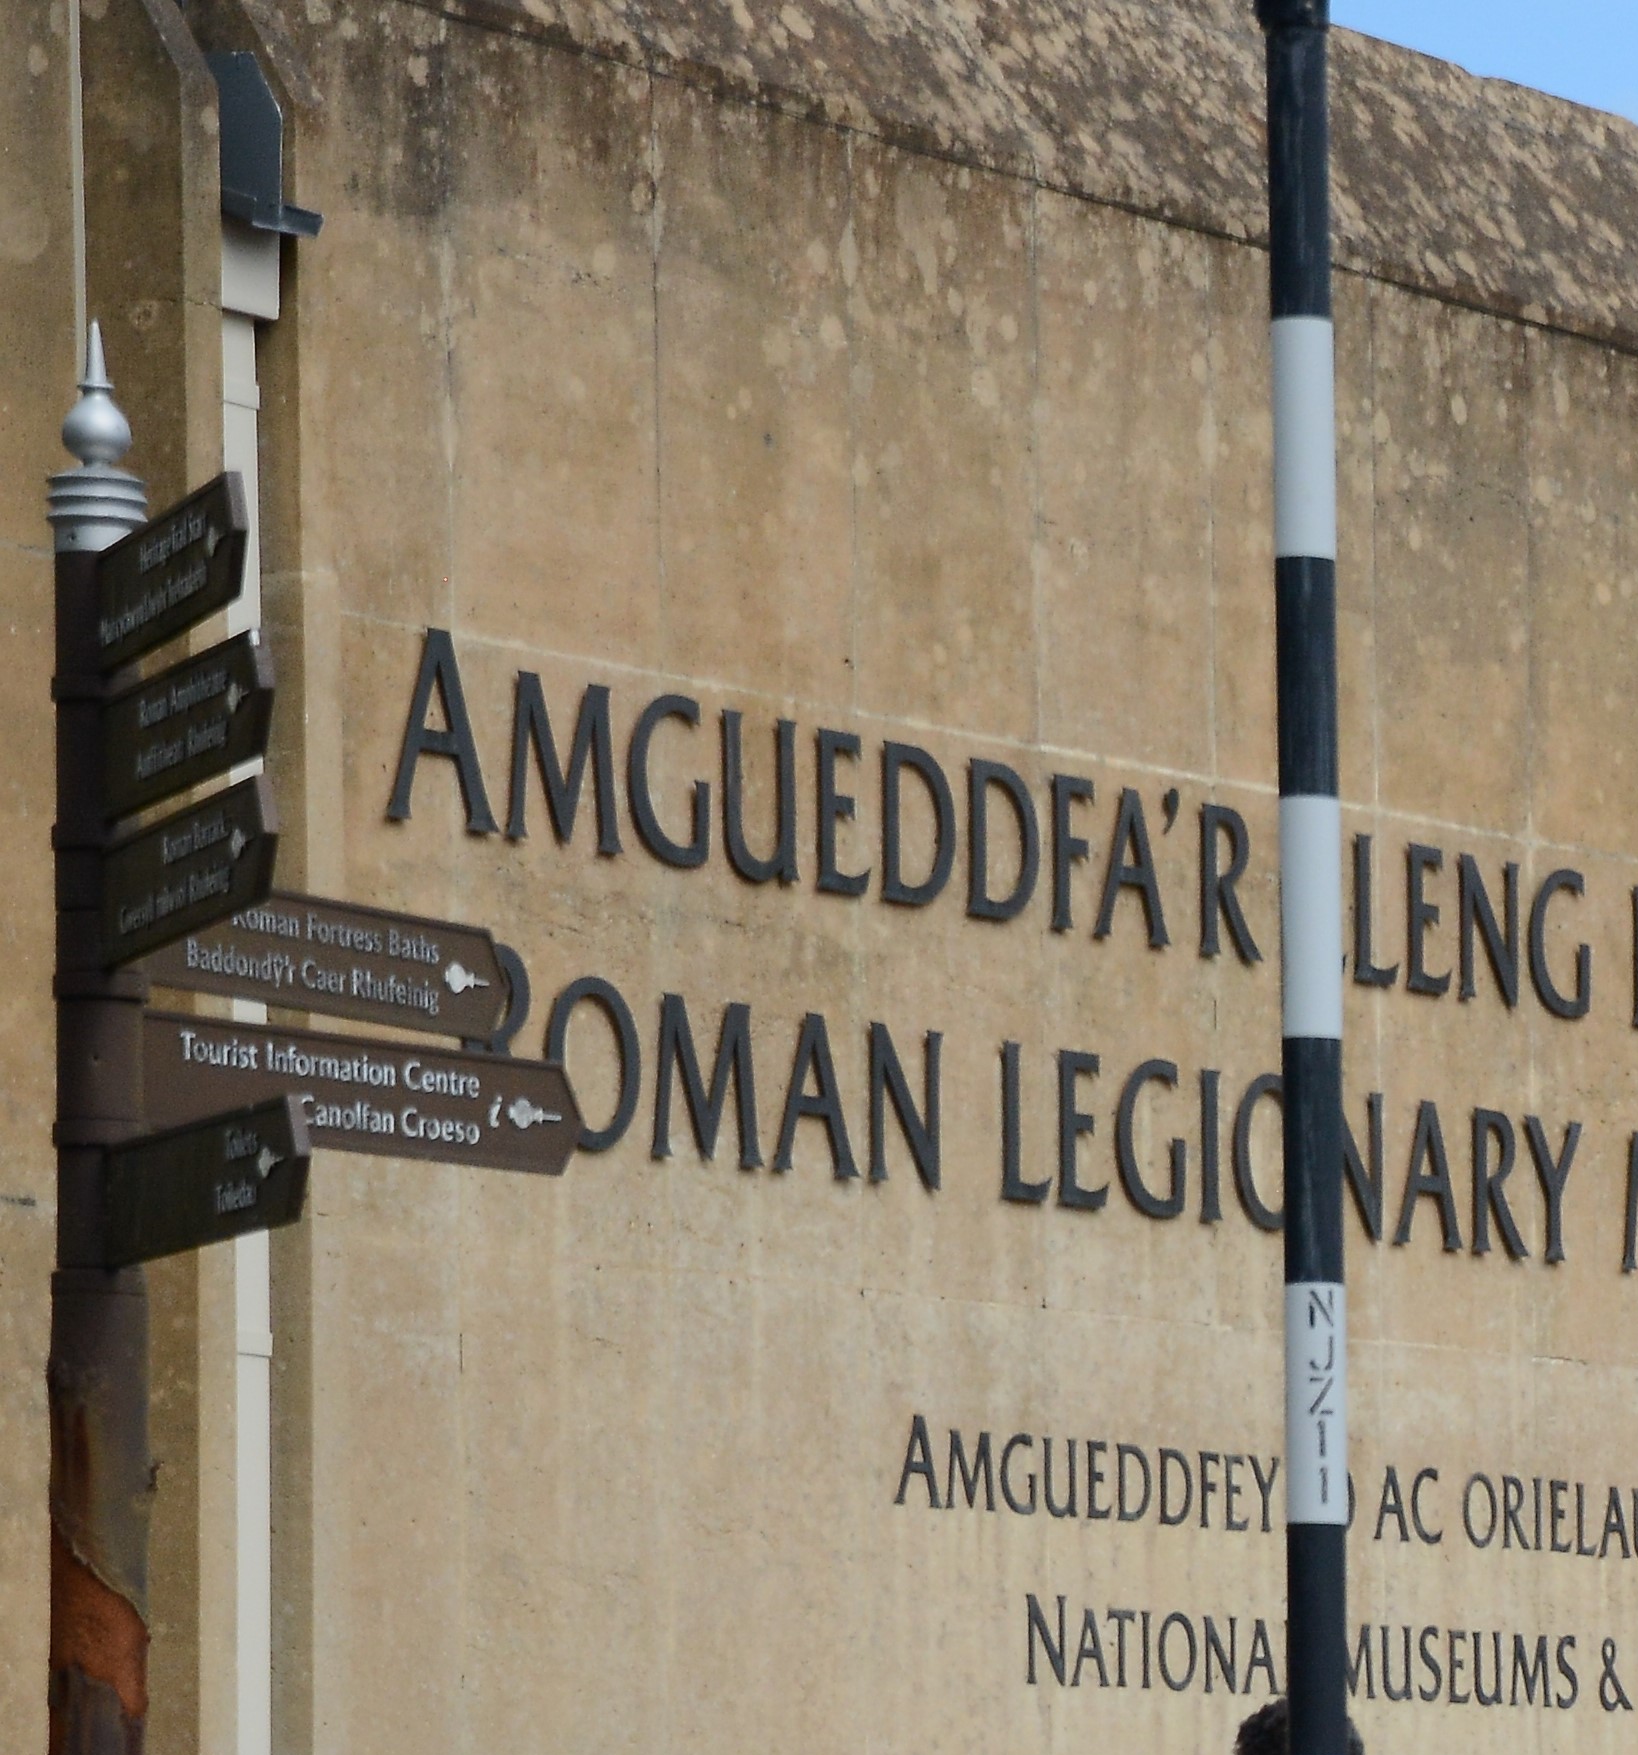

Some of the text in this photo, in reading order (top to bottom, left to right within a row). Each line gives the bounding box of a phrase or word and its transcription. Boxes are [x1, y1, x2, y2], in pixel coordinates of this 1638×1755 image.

[385, 626, 1263, 964] AMGUEDDFA'R
[1343, 832, 1592, 1020] LENG
[306, 911, 383, 955] Fortress
[387, 928, 440, 966] Baths
[300, 958, 346, 996] Caer
[350, 968, 440, 1018] Rhufeinig
[180, 1029, 481, 1099] Tourist Information Centre
[301, 1094, 396, 1136] Canolfan
[400, 1107, 482, 1146] Croeso
[1000, 1039, 1583, 1267] LEGIONARY
[894, 1413, 1357, 1536] AMGUEDDFEY
[1375, 1464, 1442, 1545] AC
[1025, 1592, 1286, 1696] NATIONA
[1346, 1622, 1579, 1710] MUSEUMS
[1599, 1636, 1633, 1713] &
